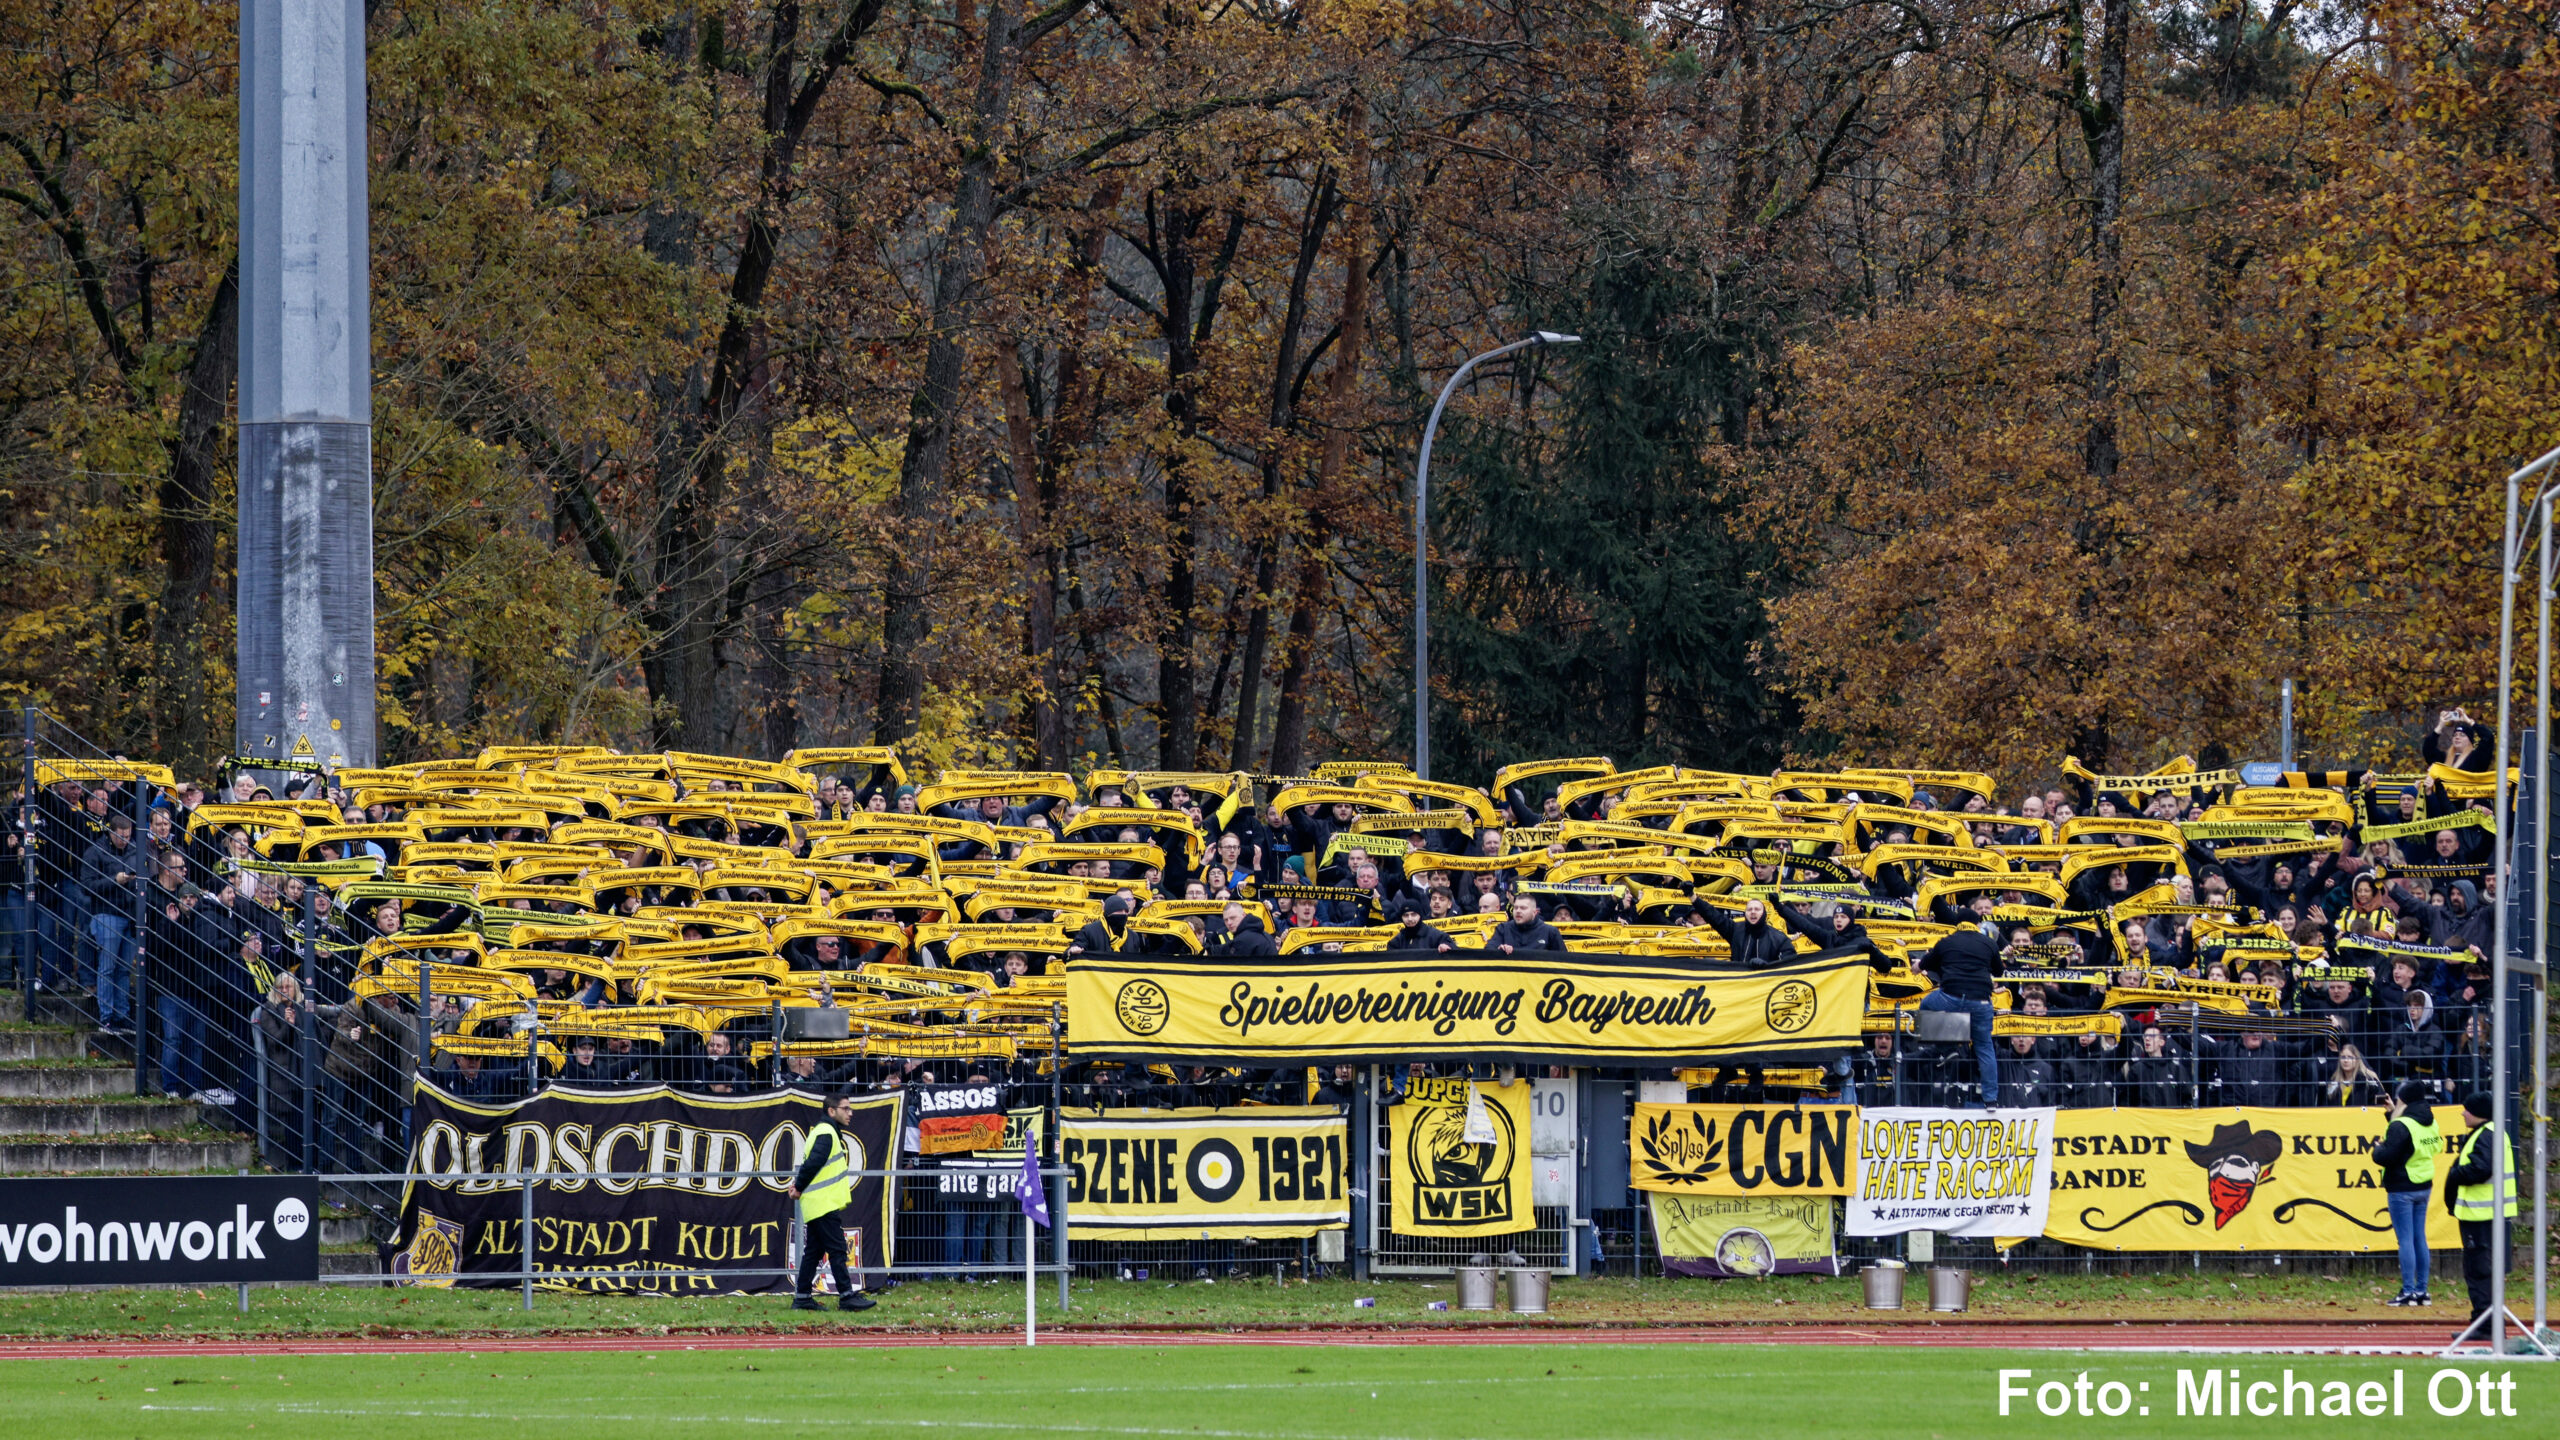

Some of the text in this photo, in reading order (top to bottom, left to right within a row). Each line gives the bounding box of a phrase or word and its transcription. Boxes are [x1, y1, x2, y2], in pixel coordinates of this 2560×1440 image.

[801, 749, 888, 760] Spielvereinigung Bayreuth
[575, 756, 663, 767] Spielvereinigung Bayreuth
[685, 755, 772, 772] Spielvereinigung Bayreuth
[1515, 757, 1603, 773] Spielvereinigung Bayreuth
[424, 775, 477, 784] Spielvereinigung
[1377, 778, 1431, 789] Spielvereinigung
[1585, 769, 1667, 788] Spielvereinigung Bayreuth
[2105, 771, 2221, 788] BAYREUTH
[953, 782, 1040, 793] Spielvereinigung Bayreuth
[1644, 783, 1695, 794] Spielvereinigung
[1307, 789, 1358, 800] Spielvereinigung
[2244, 791, 2296, 801] Spielvereinigung
[745, 808, 776, 819] Bayreuth
[1625, 803, 1679, 814] Spielvereinigung
[1694, 804, 1768, 814] Spielvereinigung Bayreuth
[439, 812, 521, 822] Spielvereinigung Bayreuth
[1099, 811, 1187, 824] Spielvereinigung Bayreuth
[1865, 806, 1955, 826] Spielvereinigung Bayreuth
[872, 815, 962, 830] Spielvereinigung Bayreuth
[1373, 820, 1447, 829] BAYREUTH 1921
[2077, 819, 2164, 831] Spielvereinigung Bayreuth
[2399, 817, 2474, 835] BAYREUTH 1921
[321, 825, 375, 836] Spielvereinigung
[565, 827, 654, 839] Spielvereinigung Bayreuth
[1594, 824, 1652, 836] Spielvereinigung
[1740, 824, 1825, 835] Spielvereinigung Bayreuth
[2208, 829, 2285, 838] BAYREUTH 1921
[685, 842, 733, 855] Spielvereinigung
[834, 839, 880, 850] Spielvereinigung
[1048, 845, 1133, 856] Spielvereinigung Bayreuth
[1892, 845, 1982, 858] Spielvereinigung Bayreuth
[2087, 849, 2171, 862] Spielvereinigung Bayreuth
[789, 862, 842, 871] Spielvereinigung
[1440, 859, 1492, 868] Spielvereinigung
[1579, 860, 1667, 870] Spielvereinigung Bayreuth
[1693, 860, 1725, 869] Bayreuth
[600, 871, 682, 883] Spielvereinigung Bayreuth
[717, 872, 805, 884] Spielvereinigung Bayreuth
[2403, 871, 2458, 879] BAYREUTH
[967, 881, 1056, 893] Spielvereinigung Bayreuth
[1528, 882, 1548, 890] Die
[852, 893, 940, 903] Spielvereinigung Bayreuth
[1275, 891, 1357, 902] BAYREUTH 1921
[484, 909, 521, 917] Forschder
[656, 908, 712, 919] Spielvereinigung
[724, 904, 779, 913] Spielvereinigung
[1139, 919, 1170, 929] Bayreuth
[1448, 916, 1478, 926] Bayreuth
[804, 921, 885, 934] Spielvereinigung Bayreuth
[947, 925, 1036, 934] Spielvereinigung Bayreuth
[1307, 929, 1394, 938] Spielvereinigung Bayreuth
[984, 937, 1038, 947] Spielvereinigung
[667, 963, 725, 976] Spielvereinigung
[844, 972, 882, 985] FORZA
[2049, 971, 2082, 980] 1921
[667, 980, 716, 989] Spielvereinigung
[1220, 978, 1716, 1036] Spielvereinigung Bayreuth
[920, 1086, 997, 1112] ASSOS
[1533, 1091, 1565, 1117] 10
[1861, 1119, 2039, 1160] LOVE FOOTBALL
[1727, 1109, 1852, 1189] CGN
[1062, 1134, 1342, 1204] SZENE 1921
[940, 1168, 978, 1193] alte
[1864, 1158, 2034, 1201] HATE RACISM
[1422, 1187, 1504, 1218] WSK
[1888, 1203, 2015, 1221] ALTSTADTFANS GEGEN RECHTS
[0, 1204, 306, 1263] wohnwork preb
[475, 1217, 779, 1259] ALTSTADT KULT
